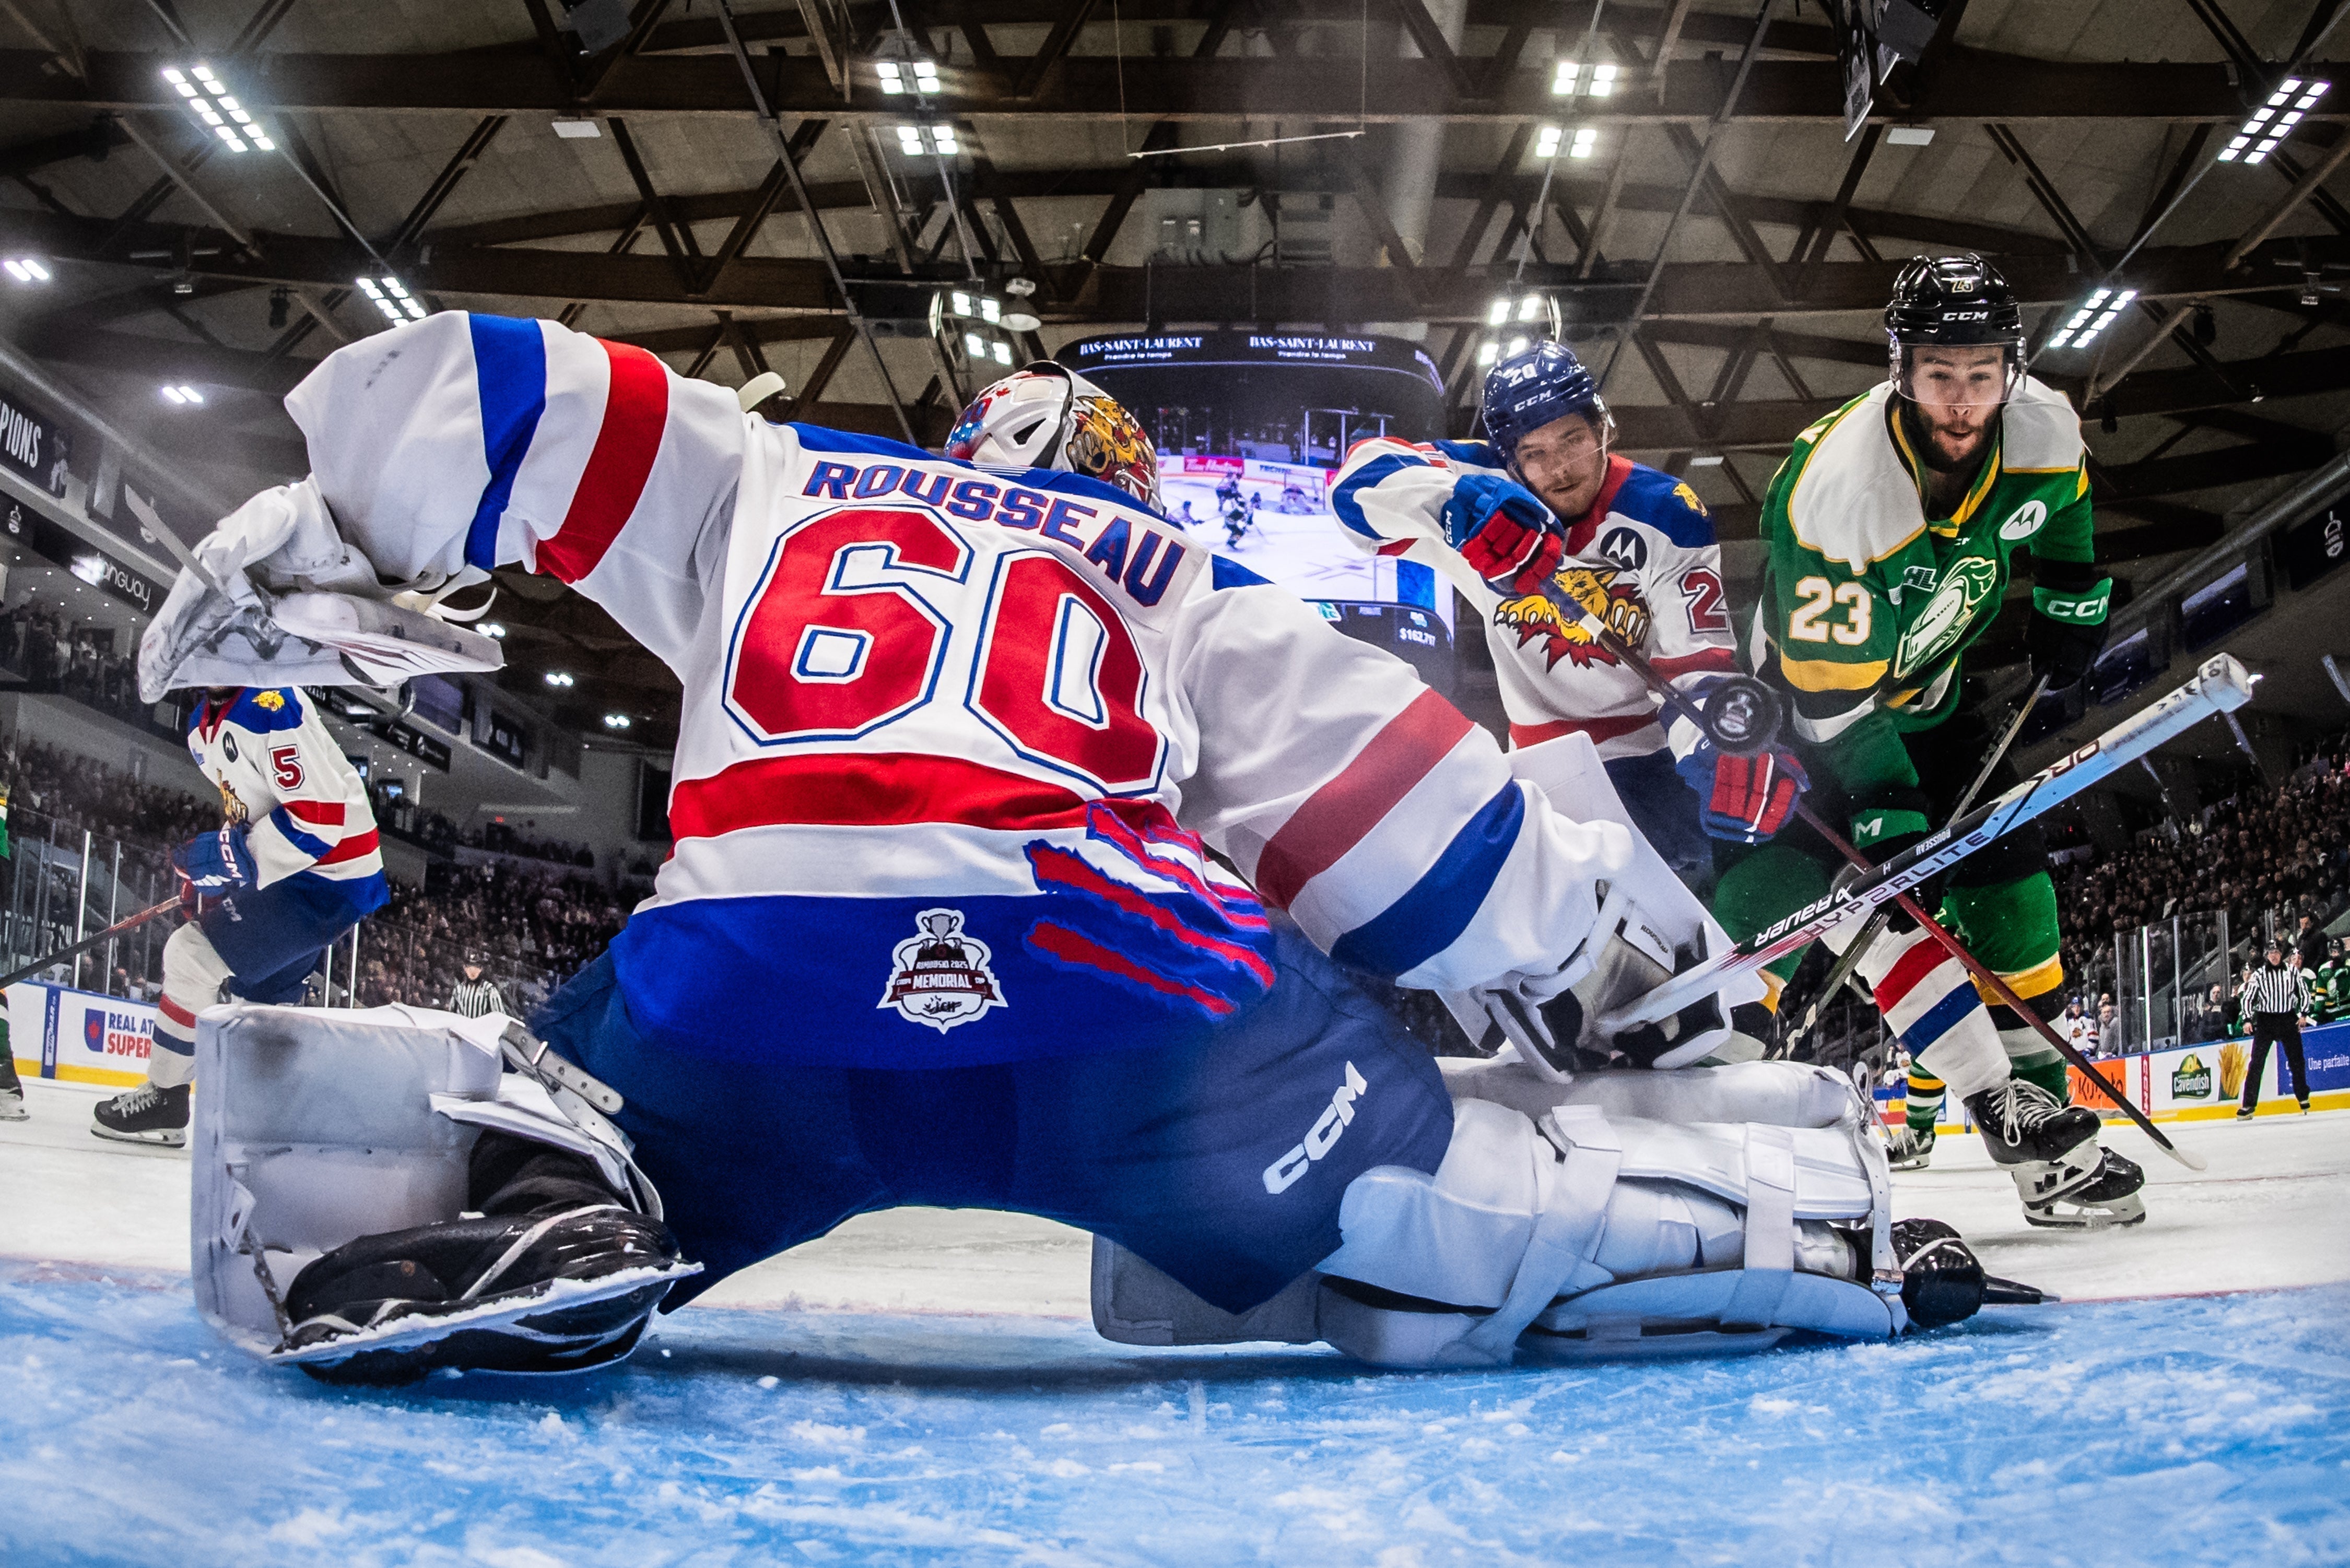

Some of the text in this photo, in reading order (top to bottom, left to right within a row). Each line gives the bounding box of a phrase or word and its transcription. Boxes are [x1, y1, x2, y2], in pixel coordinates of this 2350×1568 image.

[1942, 311, 1989, 321] CCM
[1080, 337, 1202, 356] BAS-SAINT-LAURENT
[1250, 336, 1376, 352] BAS-SAINT-LAURENT
[1514, 390, 1551, 412] CCM
[802, 461, 1185, 607] ROUSSEAU
[1789, 576, 1871, 645] 23
[722, 504, 1169, 797] 60
[268, 744, 306, 792] 5
[219, 829, 243, 878] CCM
[1916, 828, 1952, 856] ROUSSEAU
[1755, 893, 1832, 947] BAUER
[951, 960, 968, 969] 2025
[913, 974, 972, 989] MEMORIAL
[109, 1012, 136, 1032] REAL
[108, 1032, 152, 1059] SUPER
[2308, 1057, 2322, 1070] Une
[2323, 1054, 2349, 1071] parfaite
[2174, 1073, 2209, 1092] Cavendish
[1263, 1060, 1367, 1194] CCM
